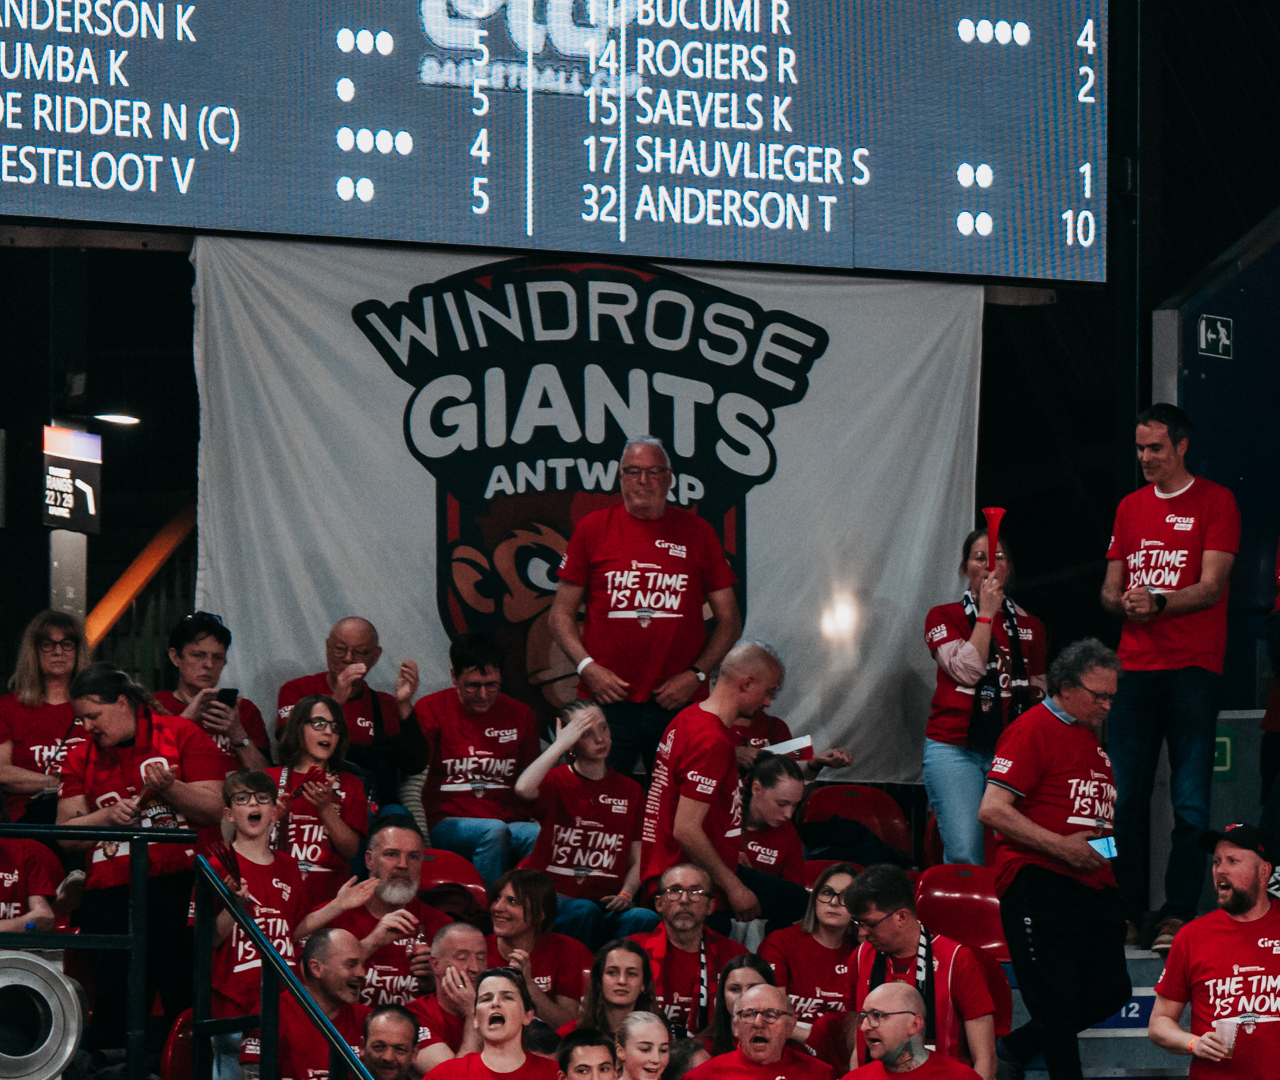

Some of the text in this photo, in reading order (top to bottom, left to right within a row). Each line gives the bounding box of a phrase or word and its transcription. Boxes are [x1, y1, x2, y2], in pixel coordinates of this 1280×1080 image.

[0, 0, 489, 66] NDERSON K 5
[637, 0, 760, 33] BUCUMI
[769, 0, 792, 35] R
[1077, 18, 1096, 54] 4
[109, 49, 129, 86] K
[472, 79, 489, 116] 5
[588, 38, 1096, 103] 14 ROGIERS R 2
[584, 86, 793, 132] 15 SAEVELS K
[0, 91, 490, 164] E RIDDER N (C) 4
[0, 144, 489, 214] ESTELOOT V 5
[583, 135, 1092, 199] 17 SHAUVLIEGER S 1
[581, 183, 1096, 247] 32 ANDERSON T 10
[365, 280, 816, 391] WINDROSE
[410, 364, 771, 477] GIANTS
[46, 475, 74, 493] RANGS
[484, 457, 705, 506] ANTWRP
[1165, 514, 1195, 524] Circus
[655, 539, 687, 552] Circus
[1127, 550, 1188, 569] THE TIME
[605, 571, 688, 596] THE TIME
[1139, 567, 1180, 586] NOW
[611, 590, 680, 610] IS NOW
[485, 729, 517, 739] Circus
[468, 757, 515, 775] TIME
[687, 771, 717, 787] Circus
[599, 795, 628, 806] Circus
[554, 825, 623, 851] THE TIME
[554, 845, 615, 869] IS NOW
[1205, 977, 1243, 1001] THE
[1120, 1002, 1141, 1018] 12
[1210, 994, 1234, 1016] IS
